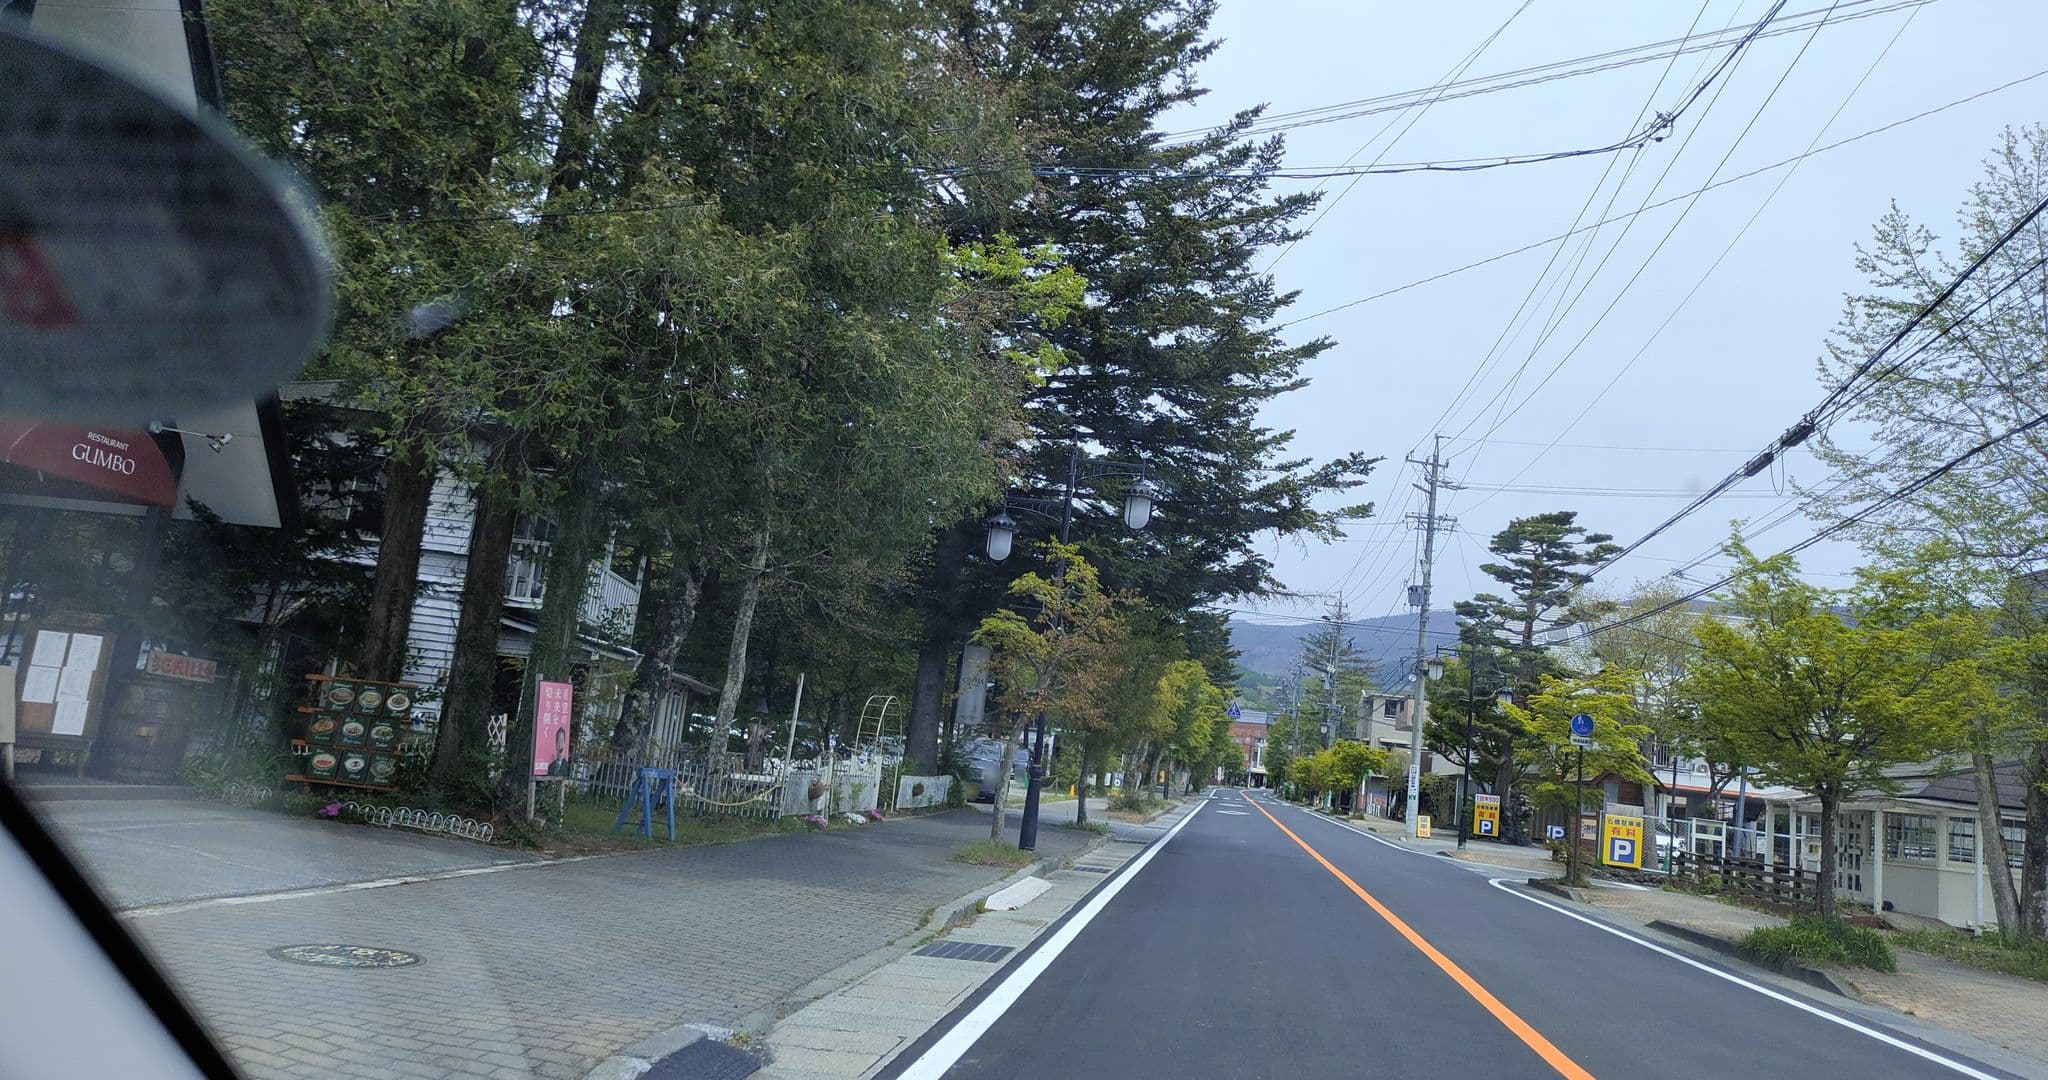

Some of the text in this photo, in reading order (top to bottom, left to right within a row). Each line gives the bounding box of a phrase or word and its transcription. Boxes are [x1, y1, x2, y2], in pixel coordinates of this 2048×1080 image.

[88, 431, 129, 451] RESTAURANT
[72, 443, 135, 475] GUMBO
[1481, 821, 1491, 833] P
[1552, 828, 1565, 839] P
[1610, 826, 1636, 838] 有料
[1613, 839, 1632, 861] P
